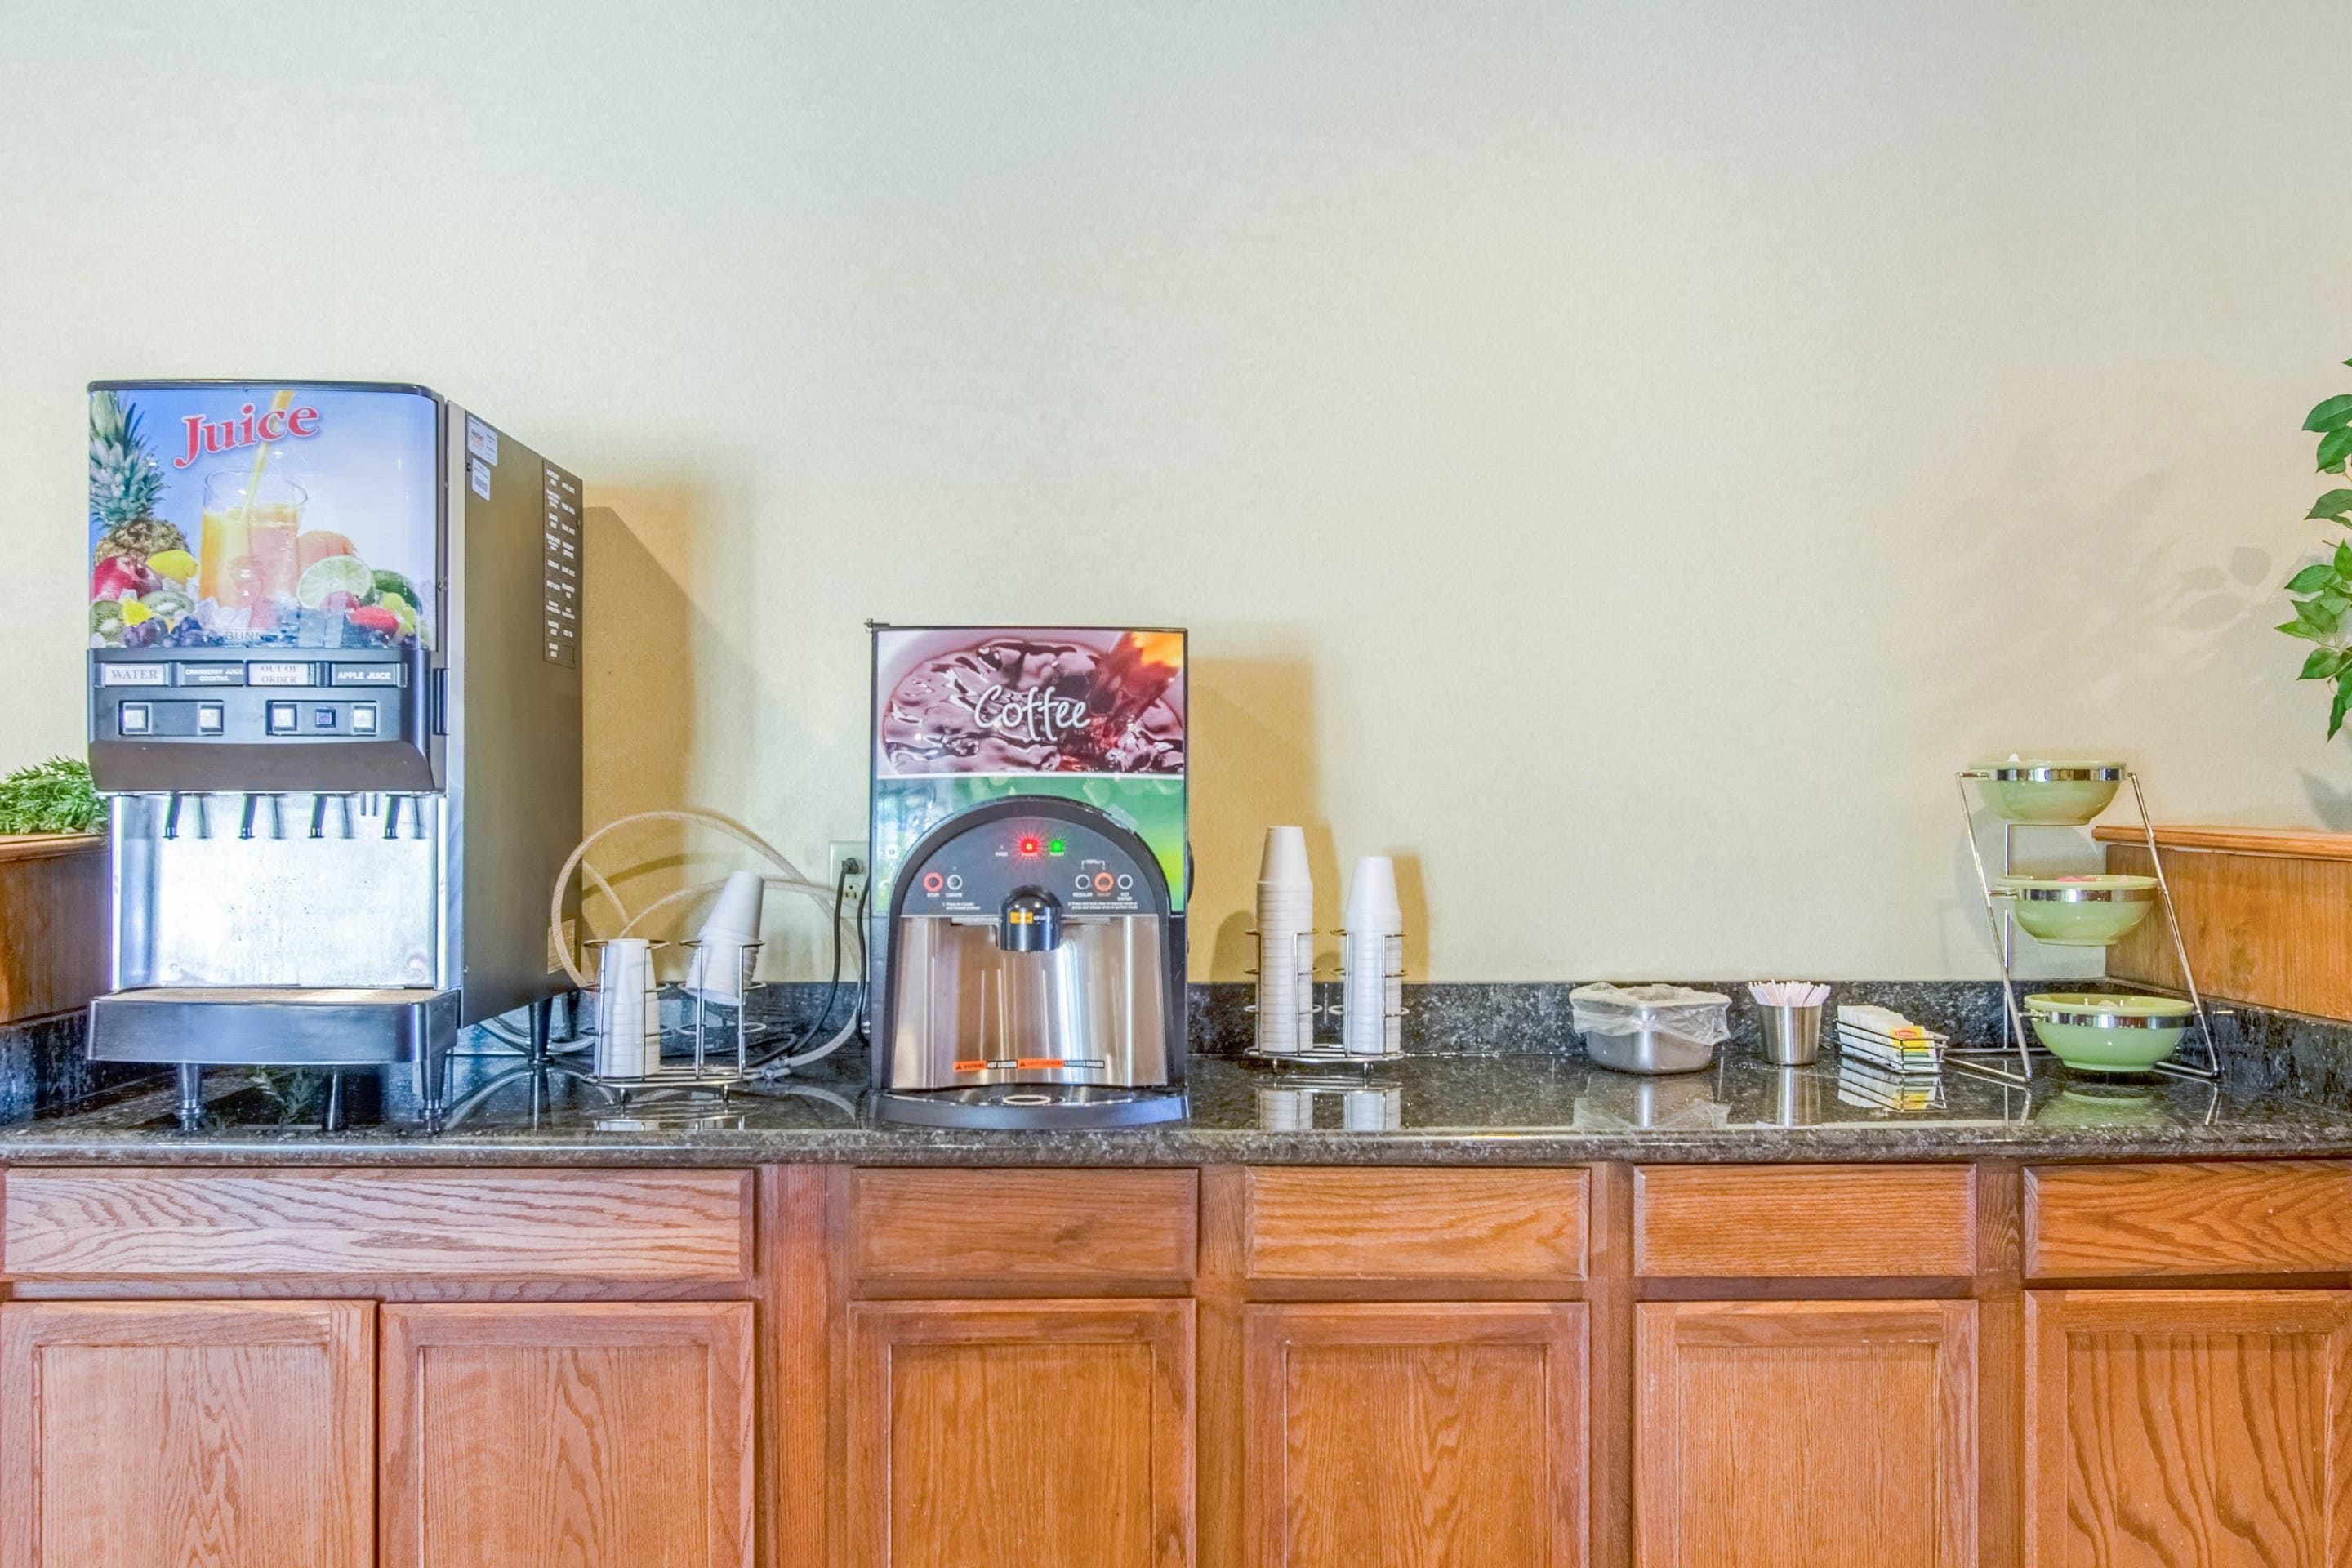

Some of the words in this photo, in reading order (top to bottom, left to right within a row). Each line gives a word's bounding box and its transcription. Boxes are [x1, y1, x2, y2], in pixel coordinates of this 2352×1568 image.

[173, 403, 318, 468] Juice
[225, 630, 262, 641] BUNN
[111, 669, 158, 679] WATER
[337, 671, 365, 679] APPLE
[367, 671, 392, 679] JUICE
[261, 675, 297, 684] ORDER
[974, 684, 1091, 741] Coffee
